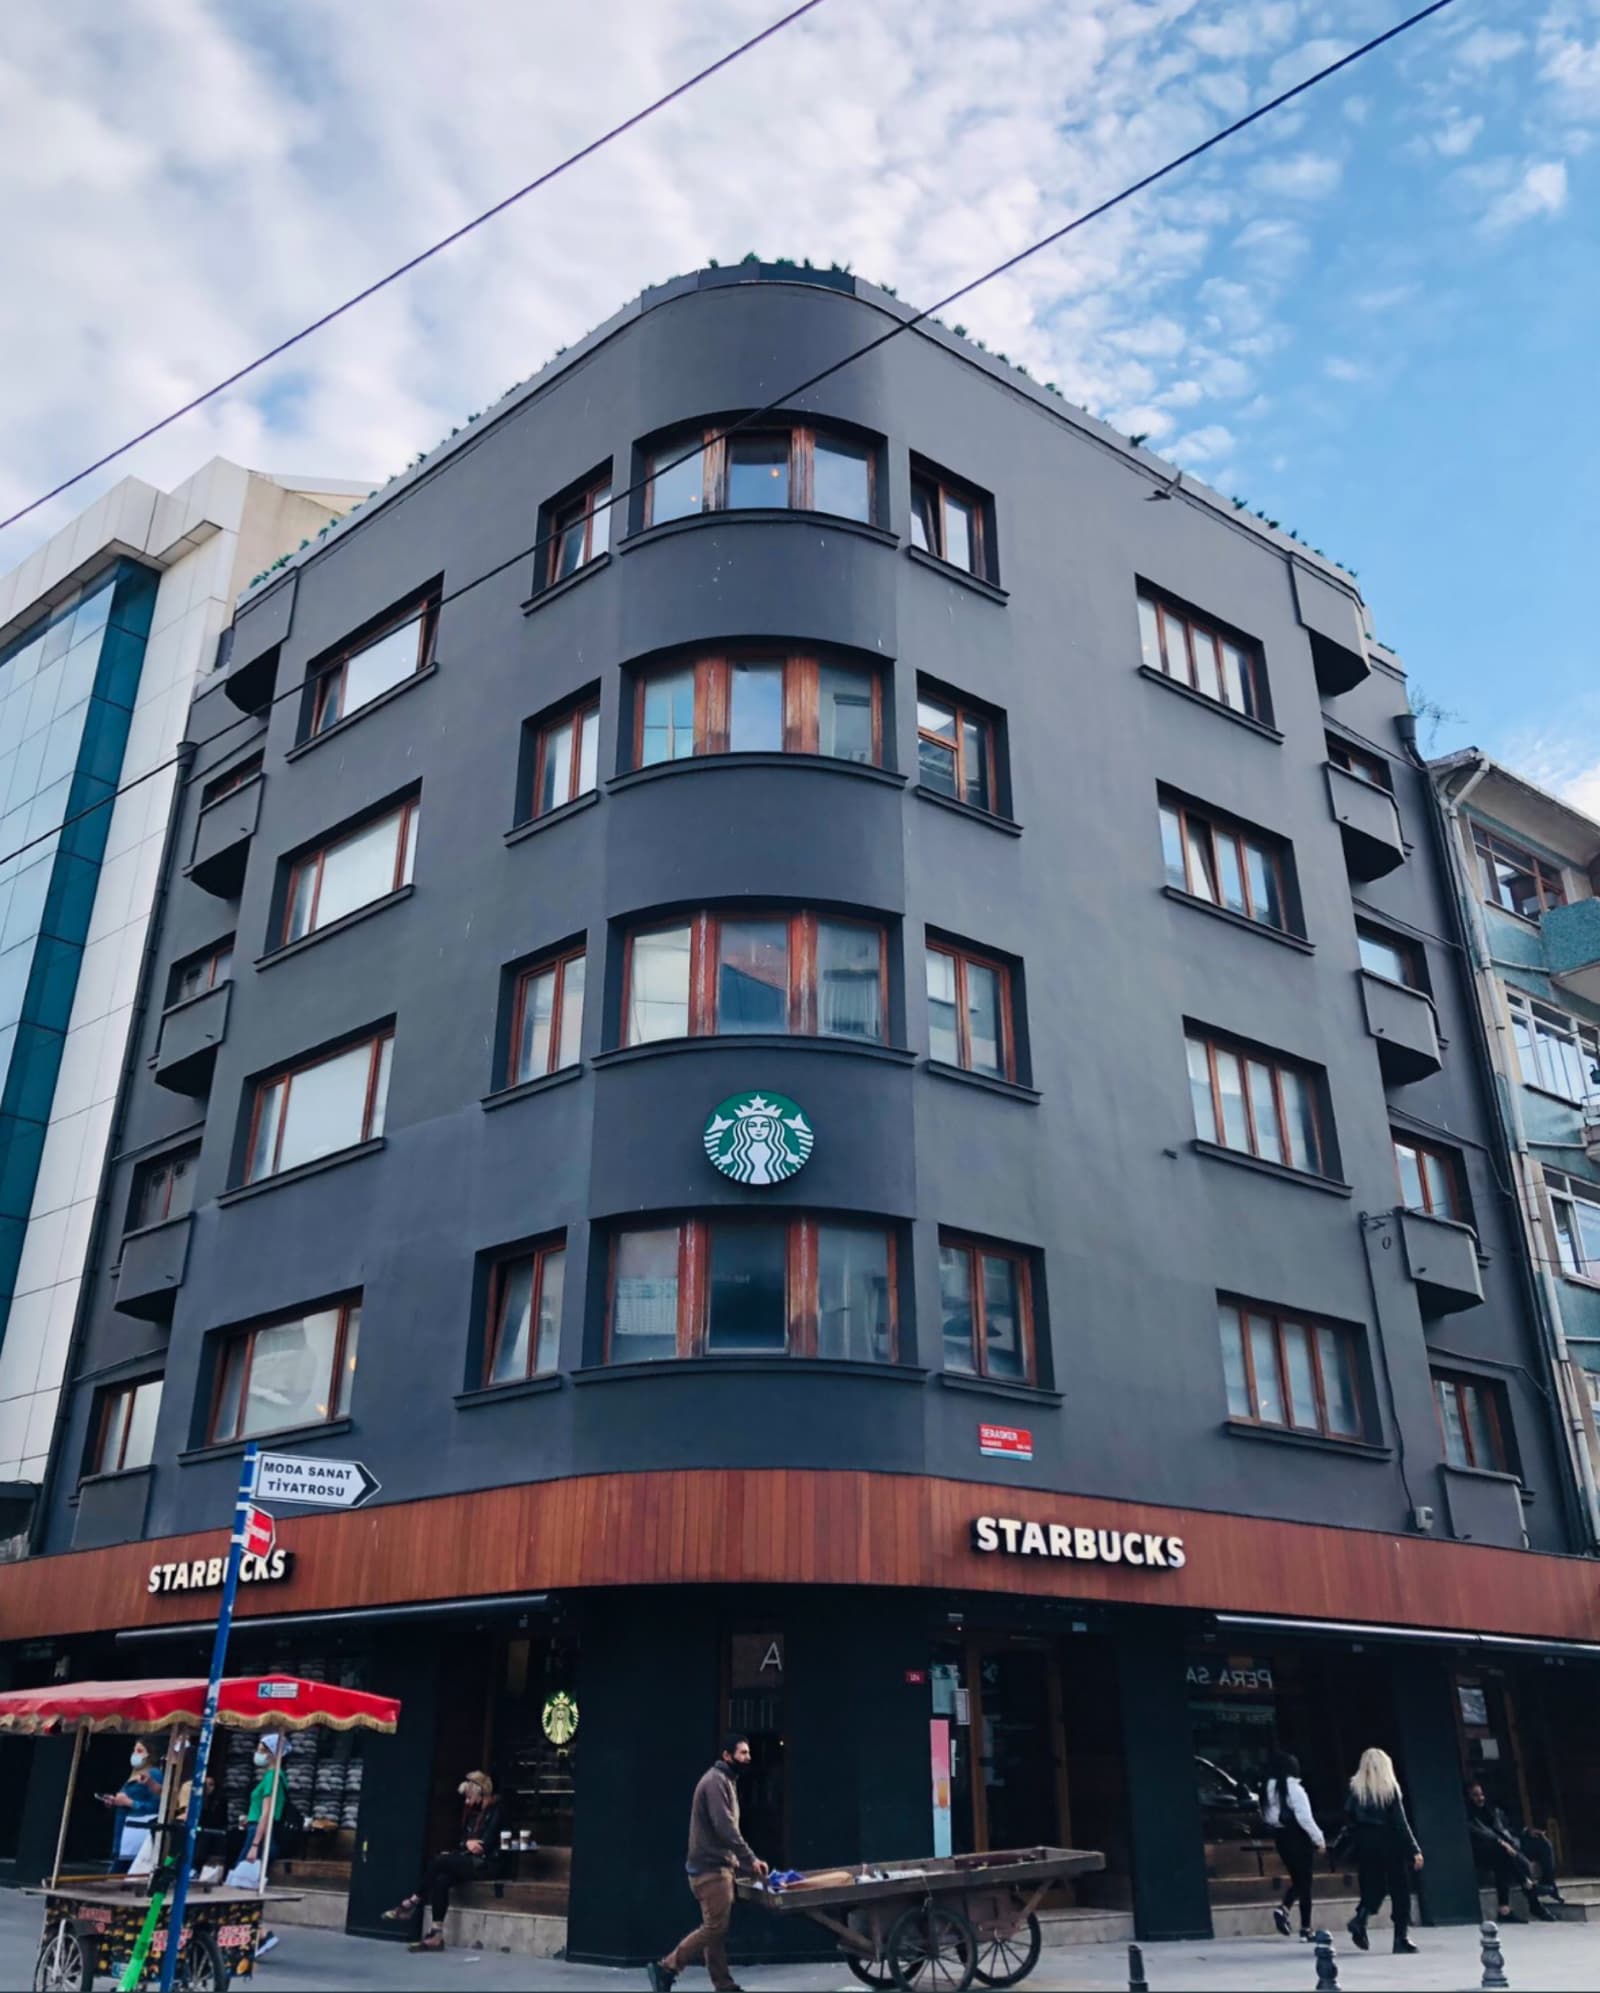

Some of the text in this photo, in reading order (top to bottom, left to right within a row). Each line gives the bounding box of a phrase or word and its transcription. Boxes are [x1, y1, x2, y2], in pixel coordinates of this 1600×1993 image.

[264, 1462, 352, 1480] MODA SANAT
[267, 1478, 345, 1497] TİYATROSU
[976, 1516, 1186, 1568] STARBUCKS
